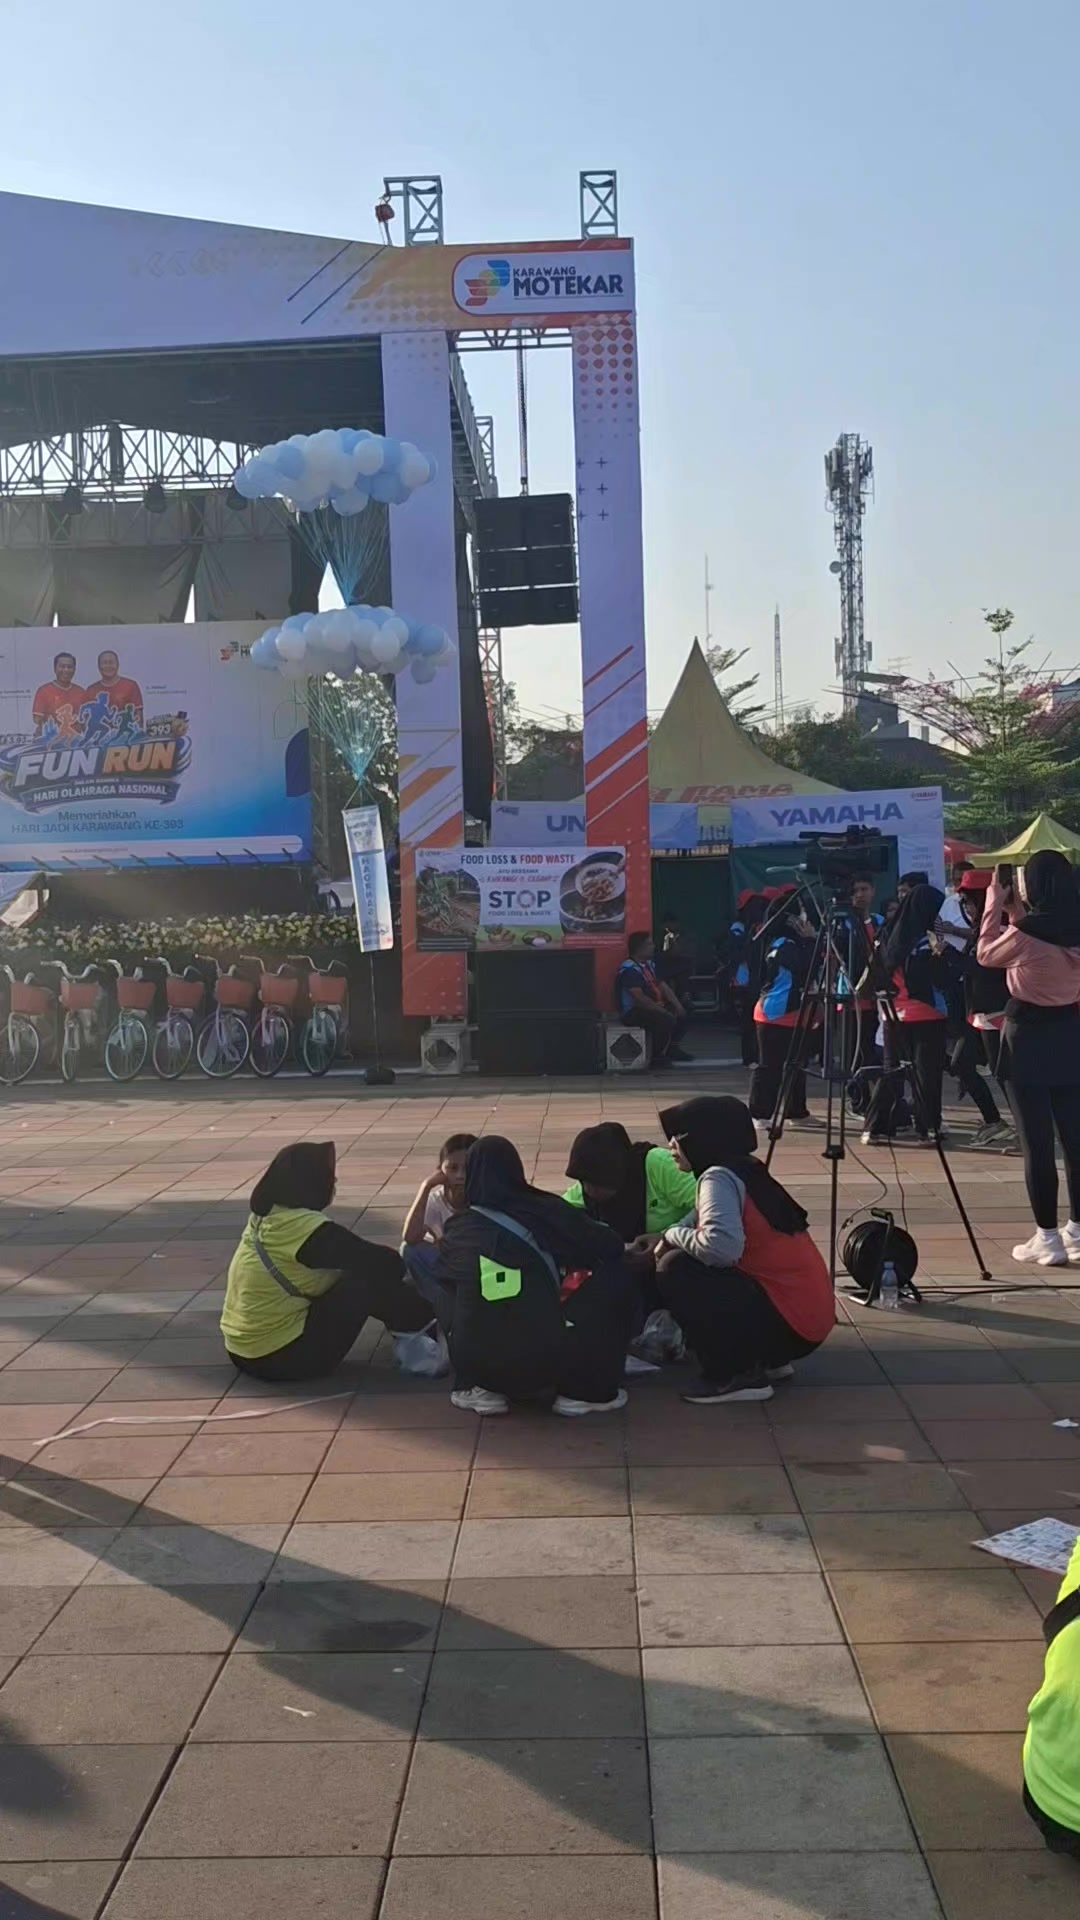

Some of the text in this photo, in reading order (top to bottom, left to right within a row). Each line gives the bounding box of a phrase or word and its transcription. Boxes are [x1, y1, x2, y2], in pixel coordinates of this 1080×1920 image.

[512, 266, 577, 277] KARAWANG
[513, 274, 624, 297] MOTEKAR
[14, 740, 177, 788] FUN RUN
[33, 784, 168, 802] HARI OLAHRAGA NASIONAL
[58, 809, 136, 821] Memeriahkan
[770, 802, 904, 827] YAMAHA
[11, 819, 184, 834] HARI JADI KARAWANG KE-393
[460, 854, 576, 866] FOOD LOSS & FOOD WASTE
[488, 889, 551, 909] STOP
